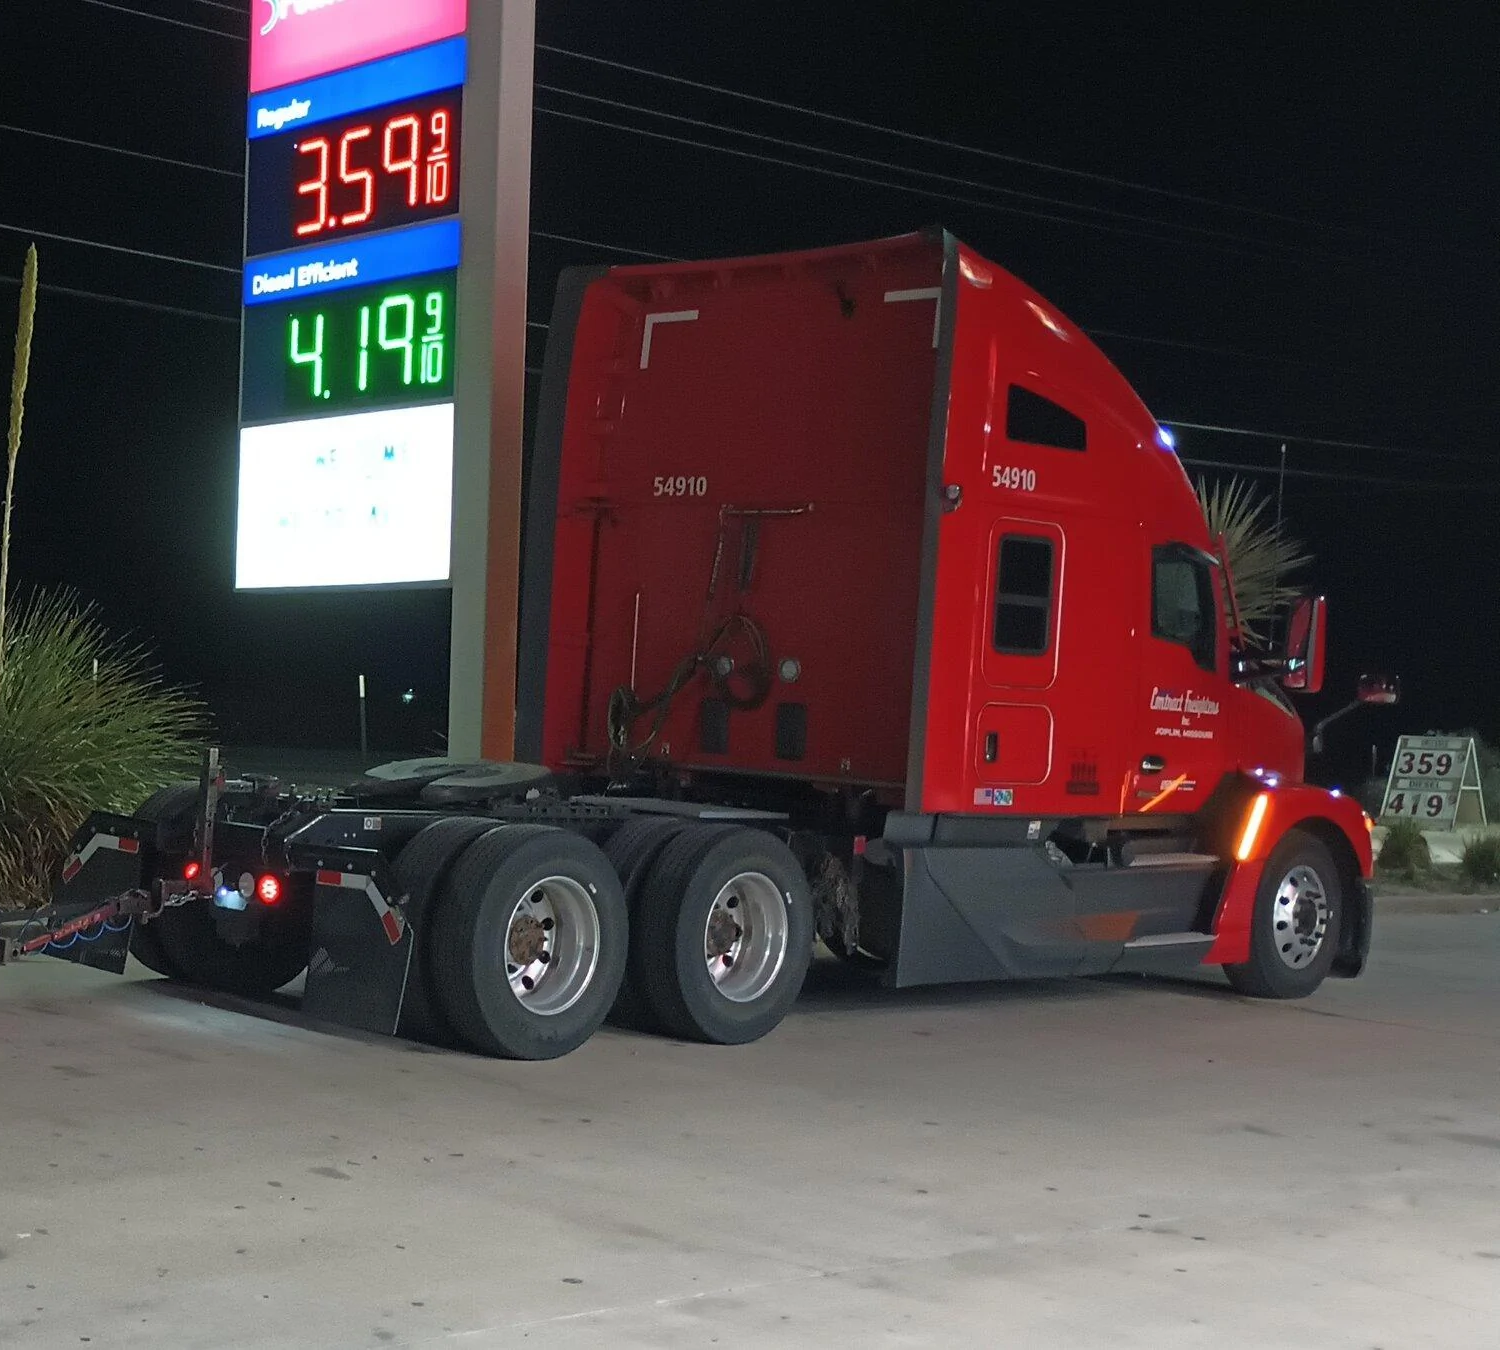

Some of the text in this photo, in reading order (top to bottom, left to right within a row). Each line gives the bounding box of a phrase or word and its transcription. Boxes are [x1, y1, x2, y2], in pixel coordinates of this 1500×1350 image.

[257, 99, 311, 129] Regular
[296, 115, 419, 235] 3.59
[252, 257, 358, 295] Diesel Efficient
[291, 293, 415, 399] 4.19
[653, 476, 708, 497] 54910
[992, 464, 1036, 492] 54910
[1398, 751, 1452, 776] 359
[1388, 793, 1443, 817] 419
